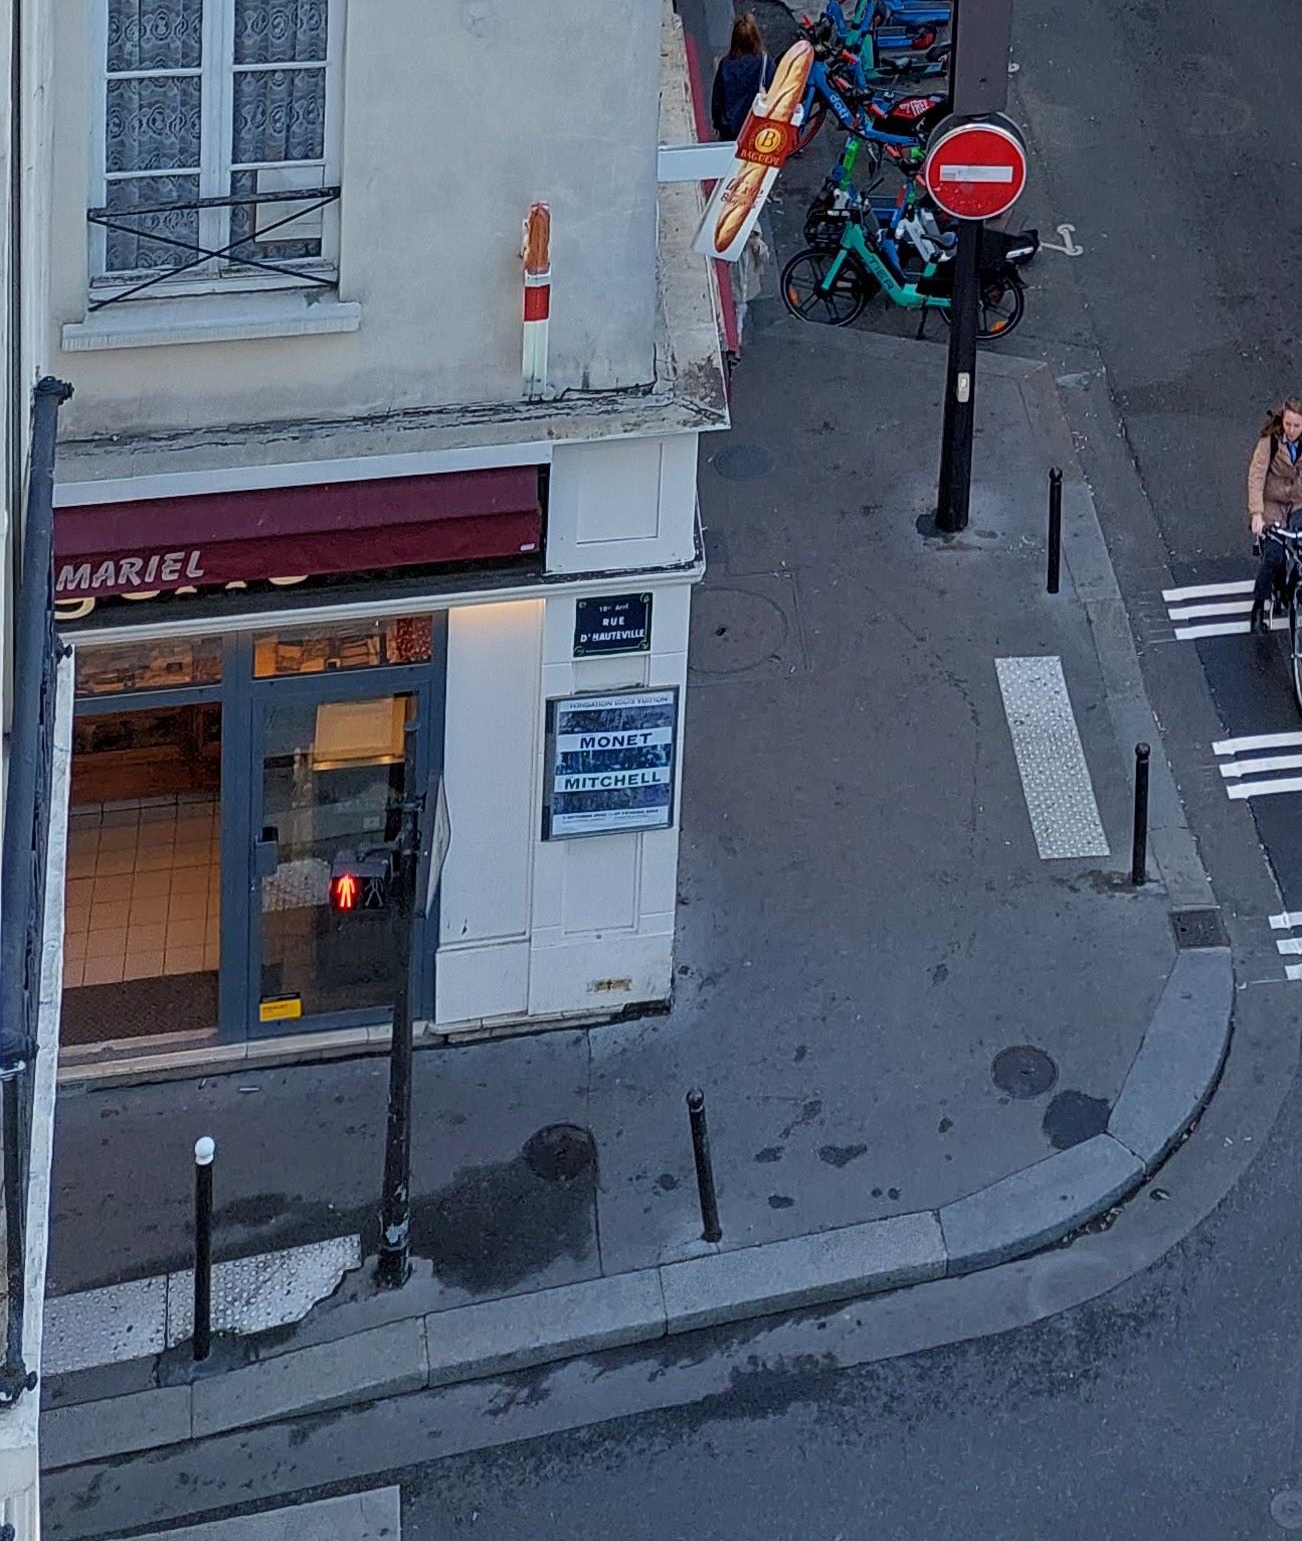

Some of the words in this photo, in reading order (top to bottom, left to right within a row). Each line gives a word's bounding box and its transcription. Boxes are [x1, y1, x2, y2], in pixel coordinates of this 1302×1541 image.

[869, 257, 895, 291] TIER
[56, 549, 205, 592] MARIEL
[602, 616, 625, 627] RUE
[580, 629, 645, 643] D'HAUTEVILLE
[580, 732, 653, 749] MONET
[564, 771, 662, 791] MITCHELL
